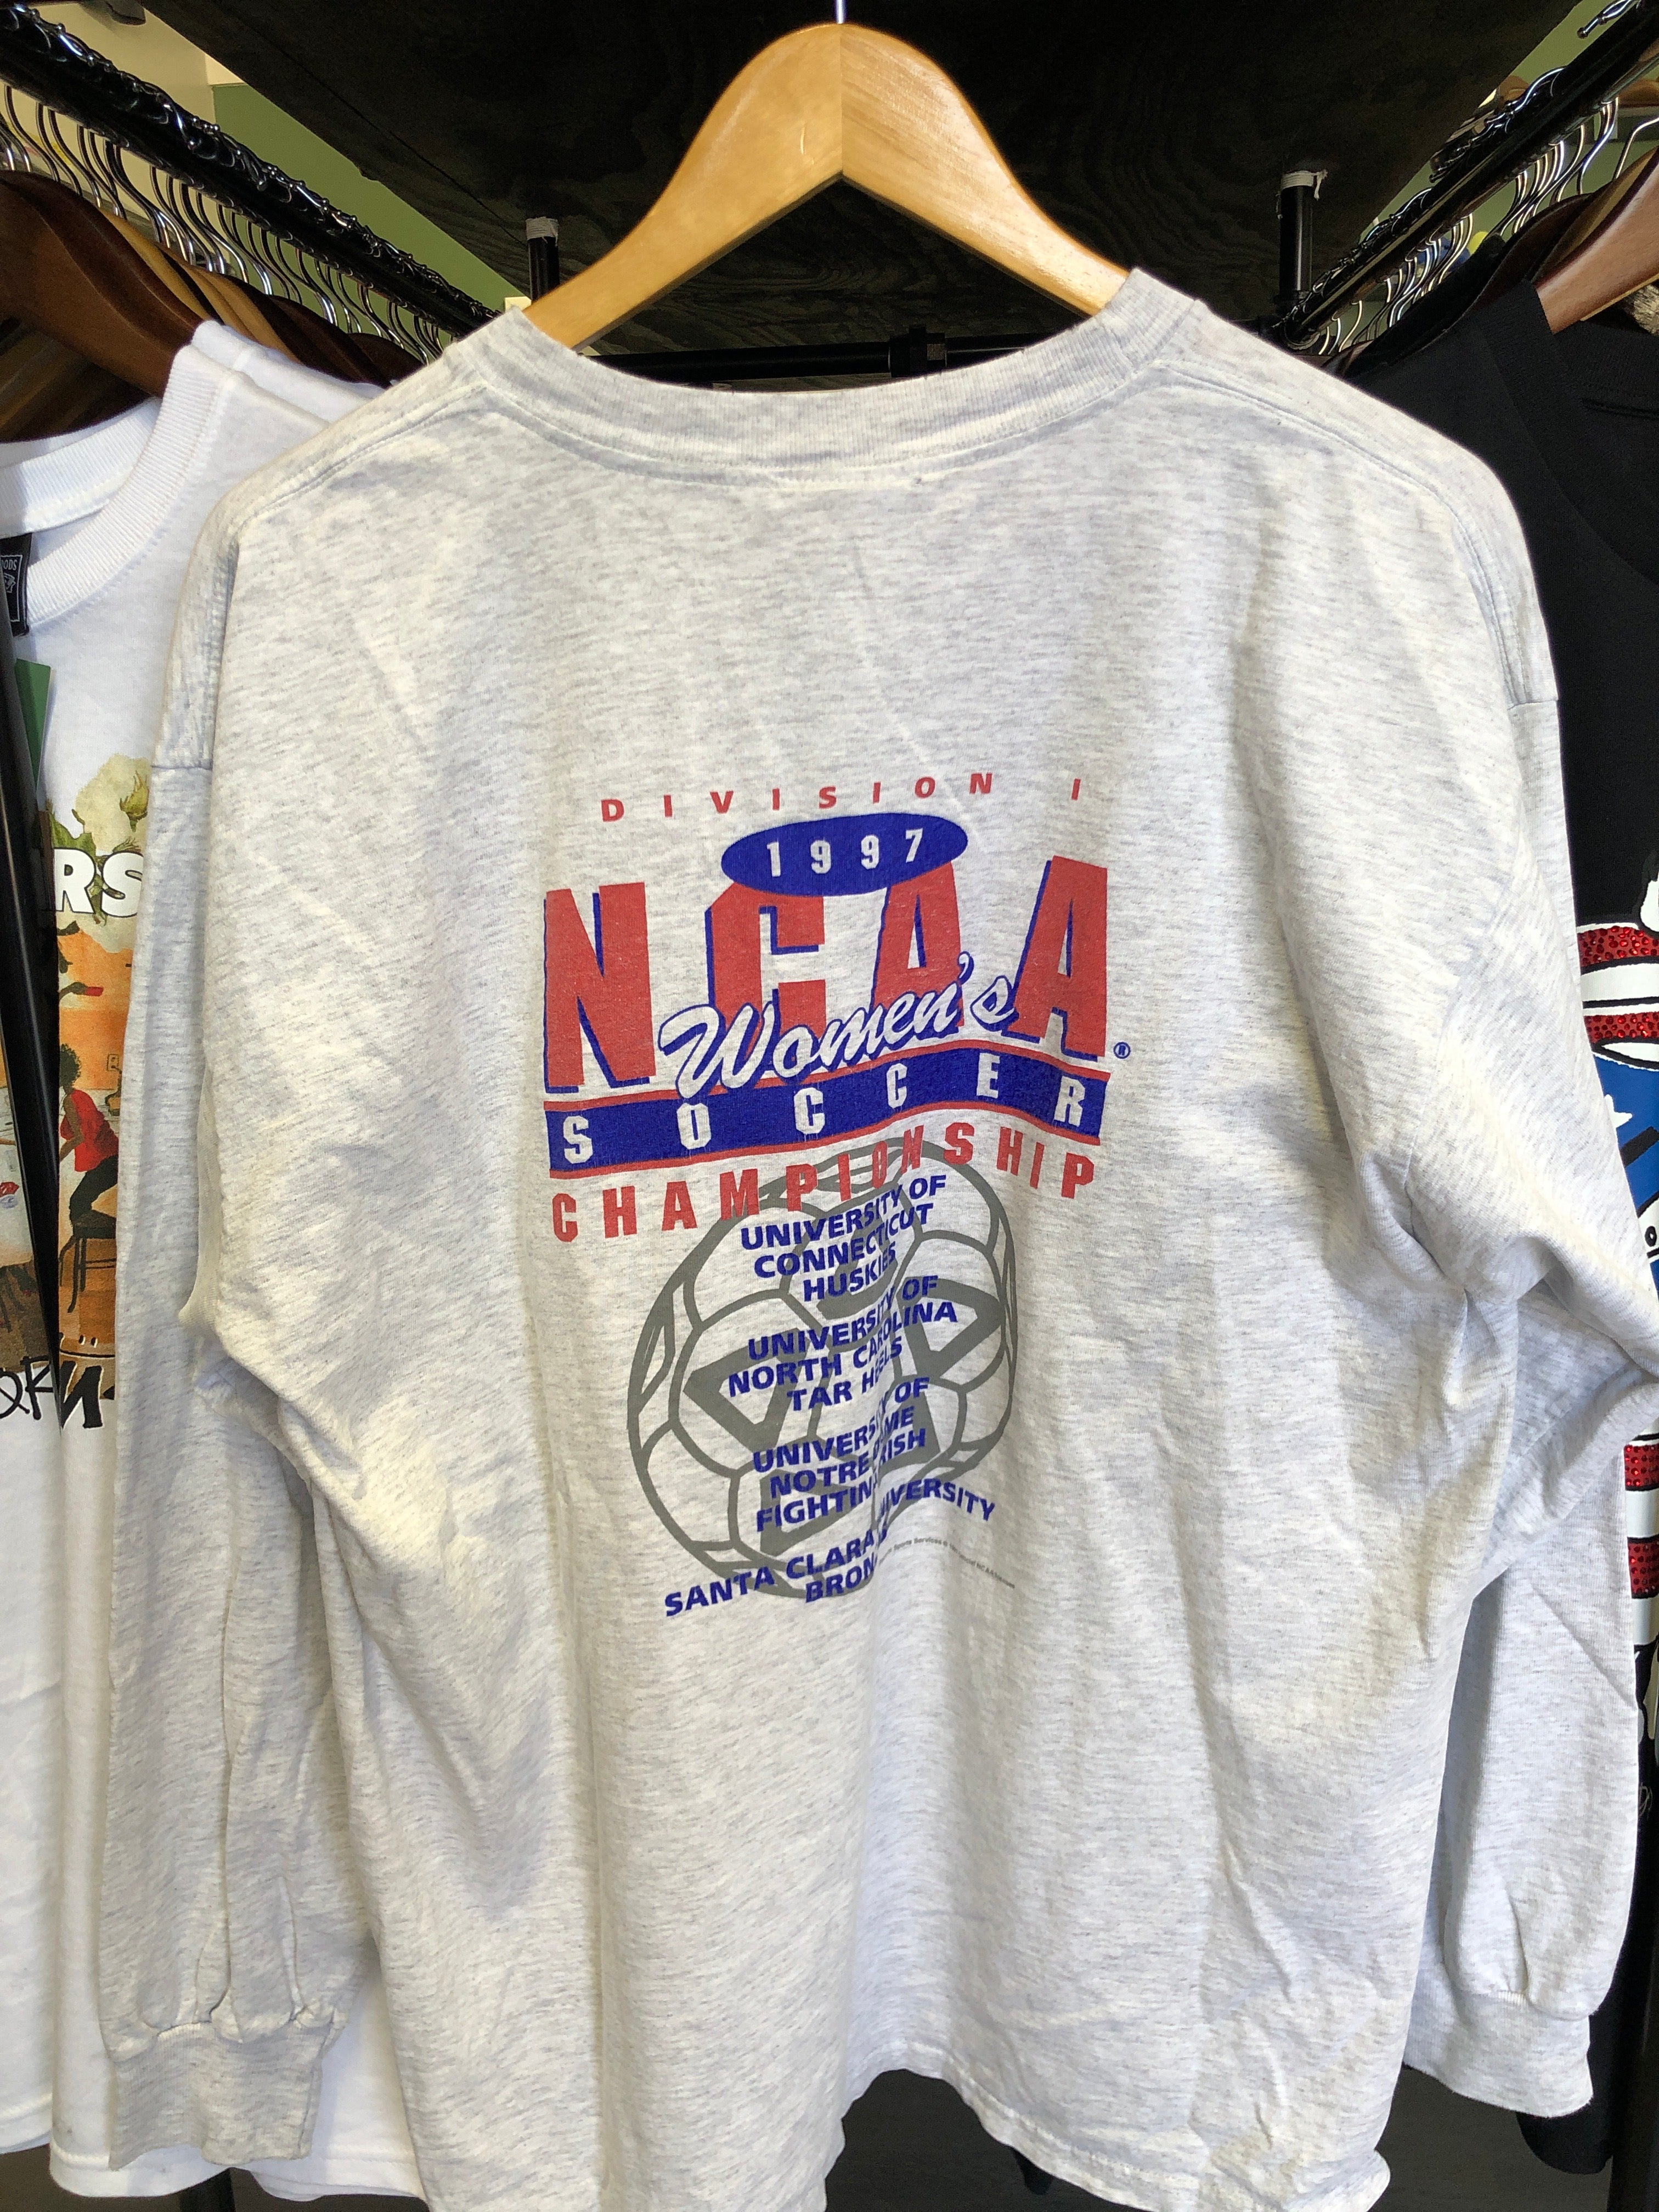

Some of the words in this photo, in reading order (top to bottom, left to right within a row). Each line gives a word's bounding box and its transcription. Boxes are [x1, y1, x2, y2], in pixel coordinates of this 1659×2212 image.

[601, 772, 993, 822] DIVISION
[1070, 778, 1081, 801] I
[766, 828, 923, 877] 1997
[544, 854, 1108, 1094] NCAA
[658, 951, 1015, 1099] Women's
[563, 1052, 1086, 1164] SOCCER
[551, 1121, 1095, 1243] CHAMPIONSHIP
[741, 1184, 902, 1250] UNIVERSITY
[909, 1174, 947, 1200] OF
[754, 1203, 934, 1279] CONNECTICUT
[803, 1240, 896, 1302] HUSKIES
[728, 1353, 843, 1397] NORTH
[852, 1301, 958, 1368] CAROLINA
[748, 1286, 896, 1361] UNIVERSITY
[901, 1274, 939, 1301] OF
[786, 1381, 853, 1411] TAR
[861, 1335, 902, 1394] HEELS
[894, 1376, 930, 1403] OF
[769, 1451, 870, 1499] NOTRE
[664, 1566, 775, 1618] SANTA
[786, 1528, 874, 1580] CLARA
[877, 1477, 996, 1532] NIVERSITY
